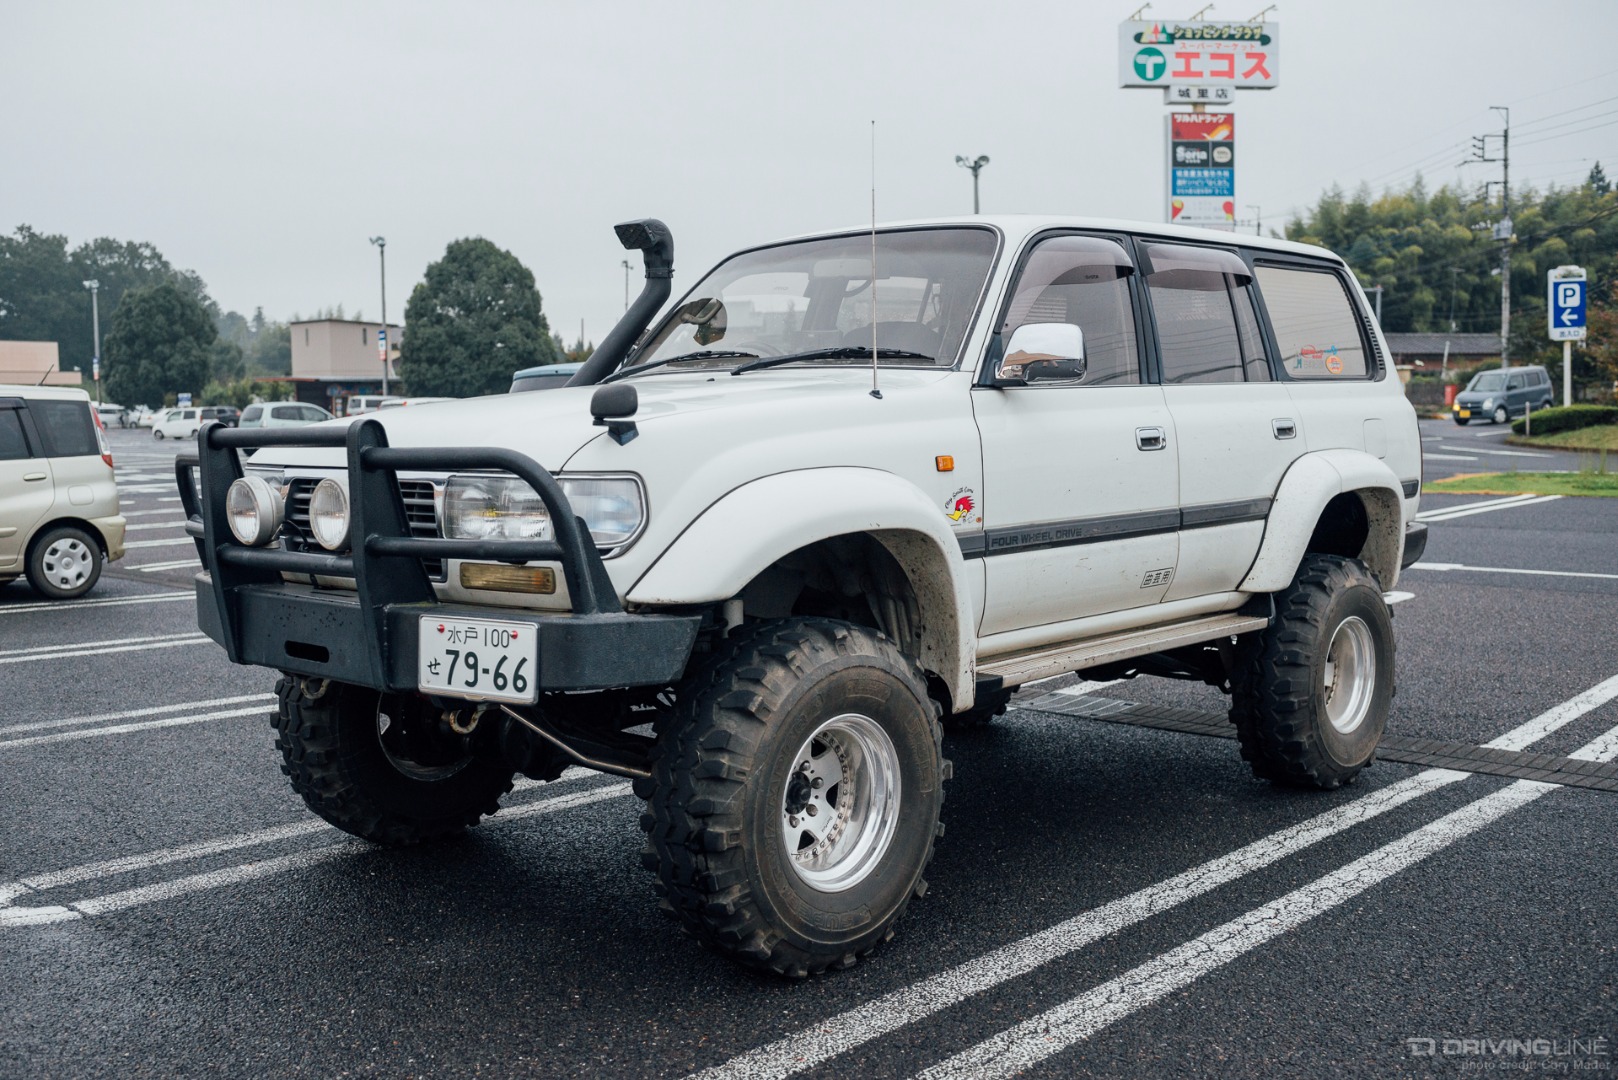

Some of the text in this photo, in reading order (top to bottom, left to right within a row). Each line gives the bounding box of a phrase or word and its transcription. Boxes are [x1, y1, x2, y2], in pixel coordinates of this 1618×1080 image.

[1179, 42, 1256, 51] スーパーマーケット
[1172, 52, 1271, 80] エコス
[1178, 88, 1228, 99] 城里店
[1176, 145, 1208, 162] Seria
[991, 528, 1082, 548] FOUR WHEEL DRIVE
[447, 625, 510, 649] 水戸 100
[427, 648, 528, 694] せ 79-66
